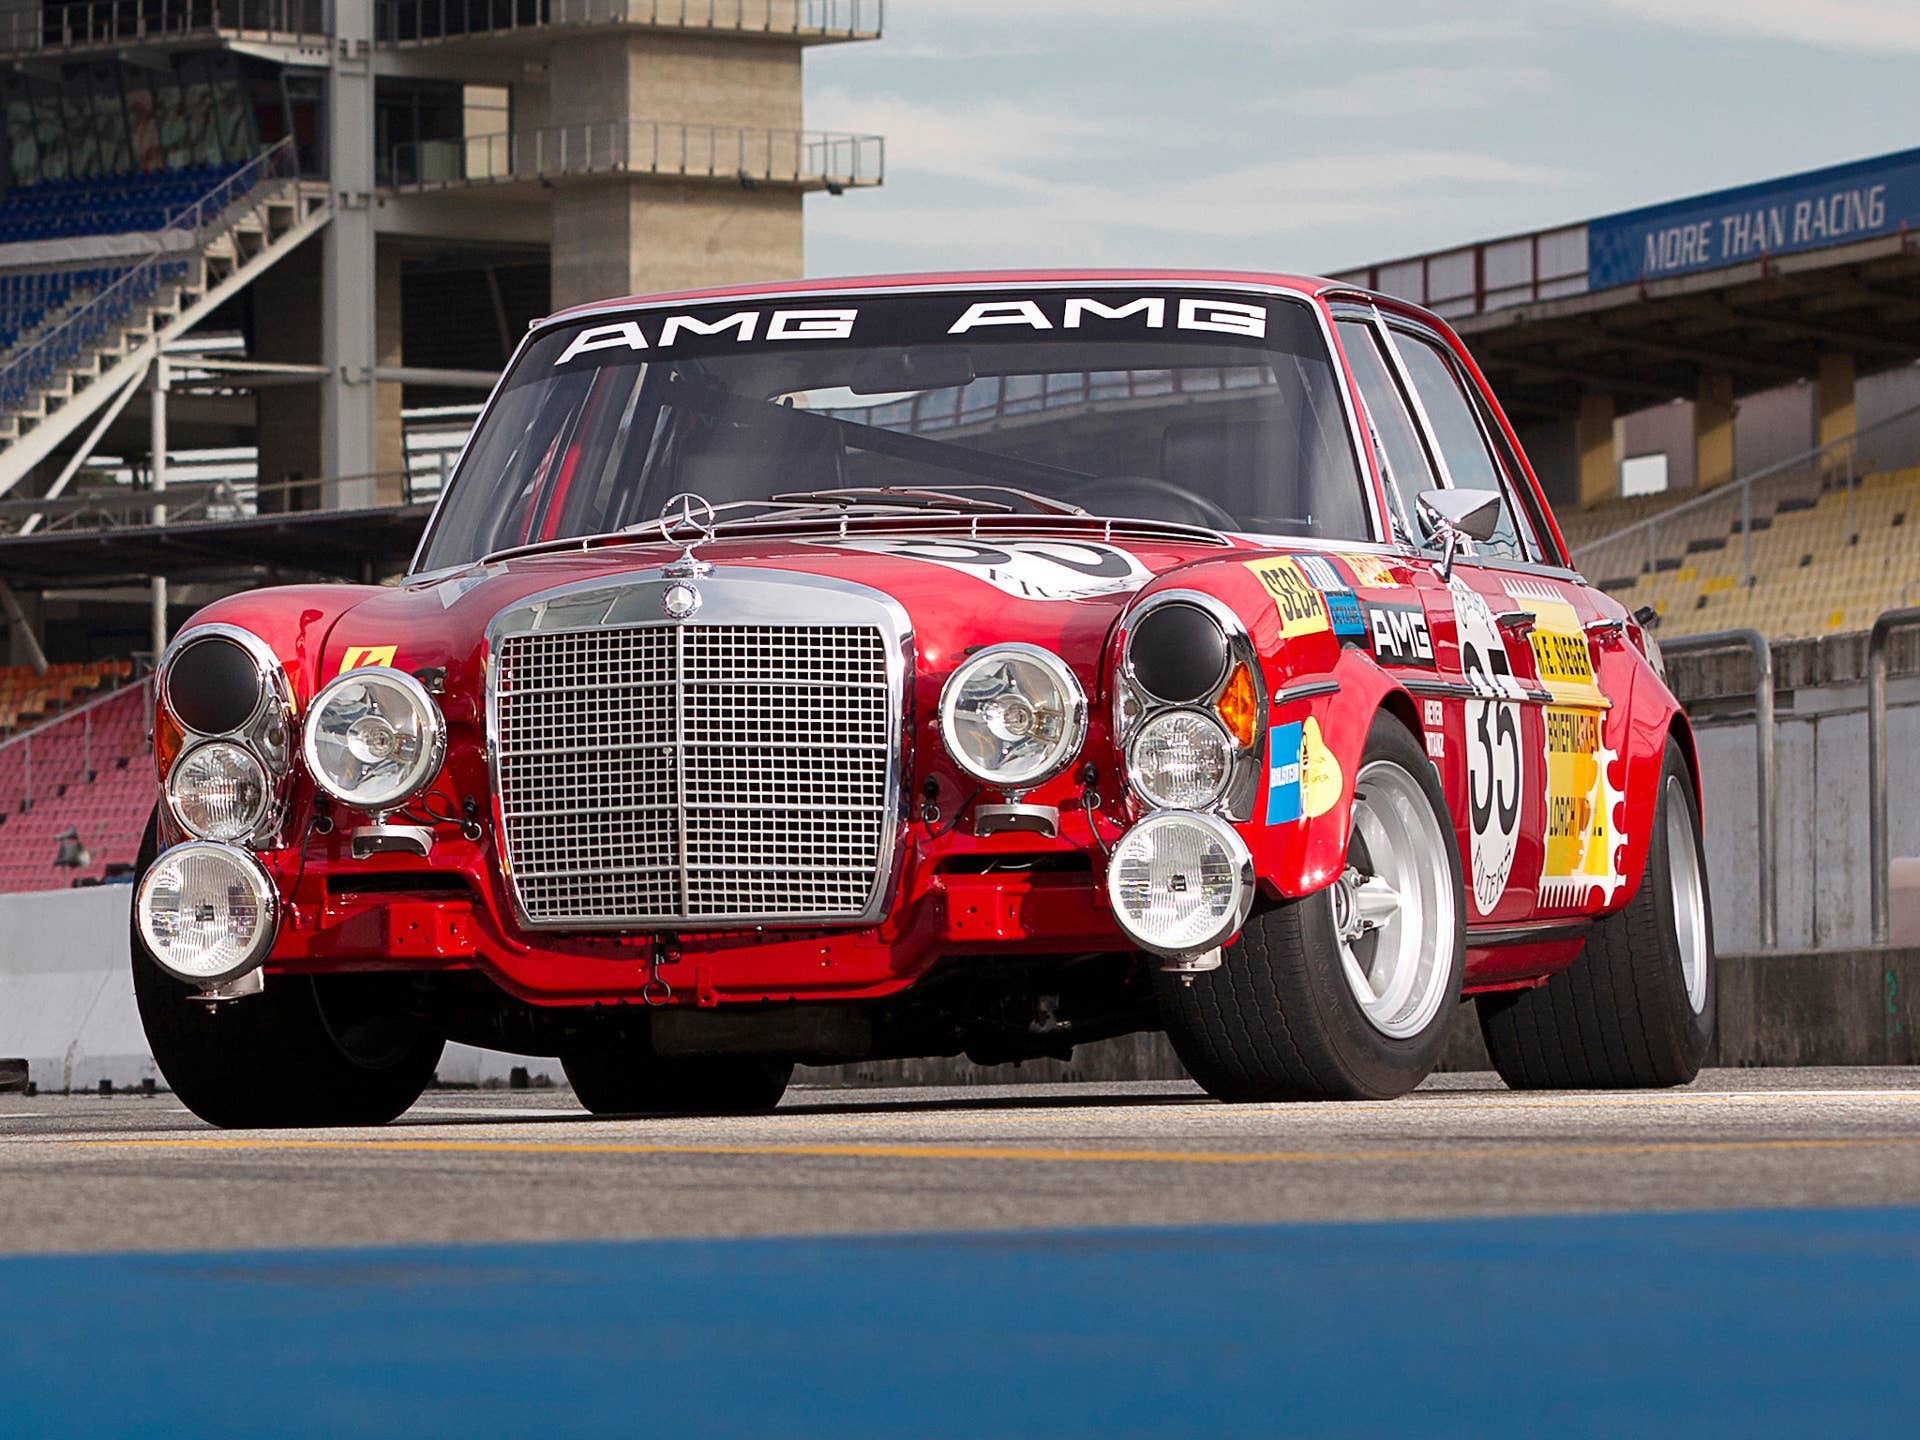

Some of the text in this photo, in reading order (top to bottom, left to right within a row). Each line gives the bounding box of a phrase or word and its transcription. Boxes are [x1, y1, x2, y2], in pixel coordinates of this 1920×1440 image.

[1643, 185, 1886, 271] MORE THAN RACING
[554, 297, 1267, 366] AMG AMG
[1368, 608, 1434, 659] AMG
[1553, 636, 1592, 676] SIEGER
[1463, 641, 1520, 835] 35
[1474, 843, 1512, 906] FILTERS
